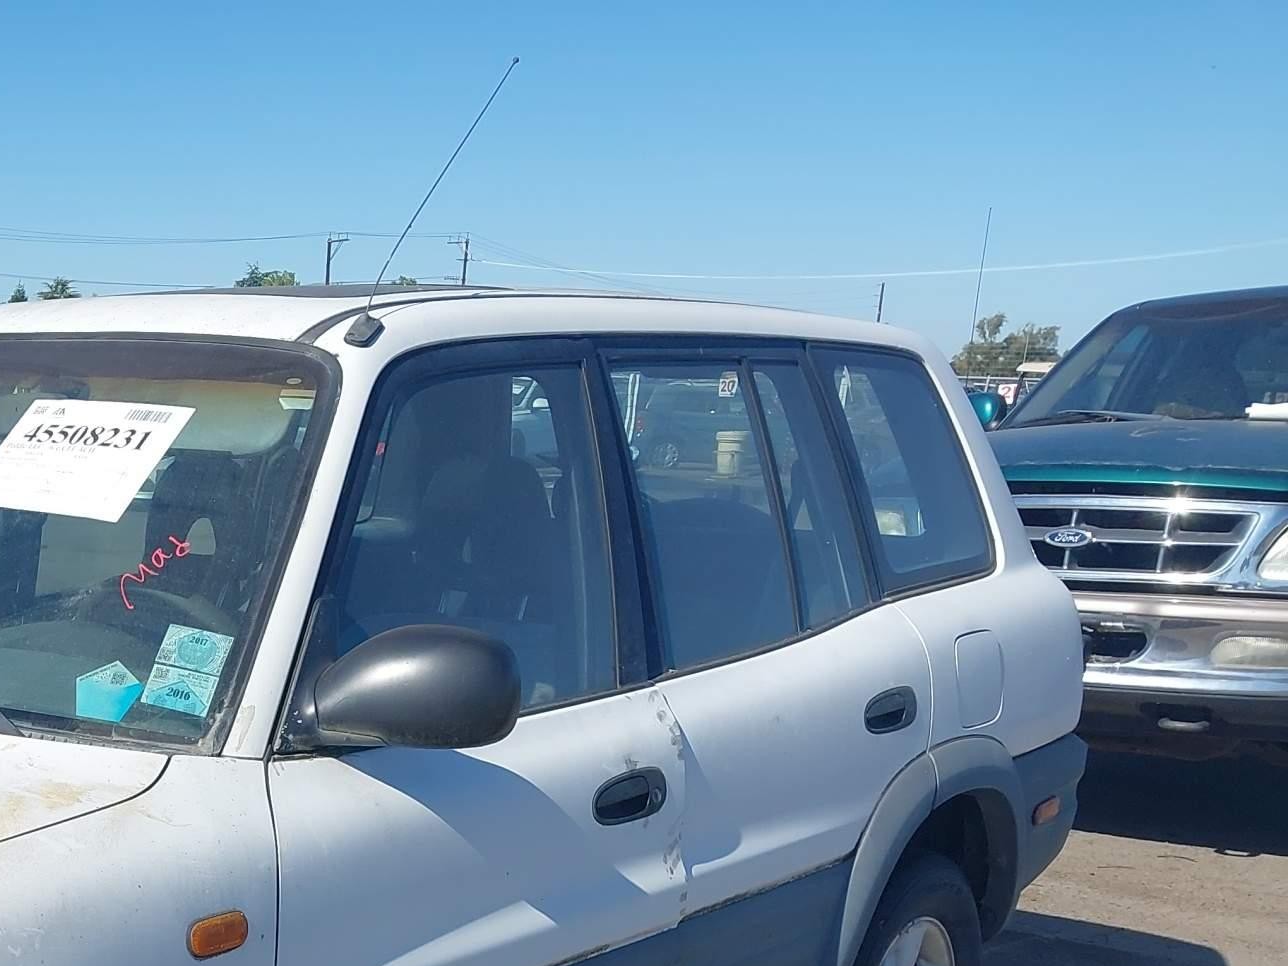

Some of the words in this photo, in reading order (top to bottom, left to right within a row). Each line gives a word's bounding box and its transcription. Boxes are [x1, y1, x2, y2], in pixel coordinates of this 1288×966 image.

[24, 424, 152, 450] 45508231
[1054, 531, 1082, 543] Ford
[189, 635, 209, 647] 2017
[166, 686, 191, 701] 2016
